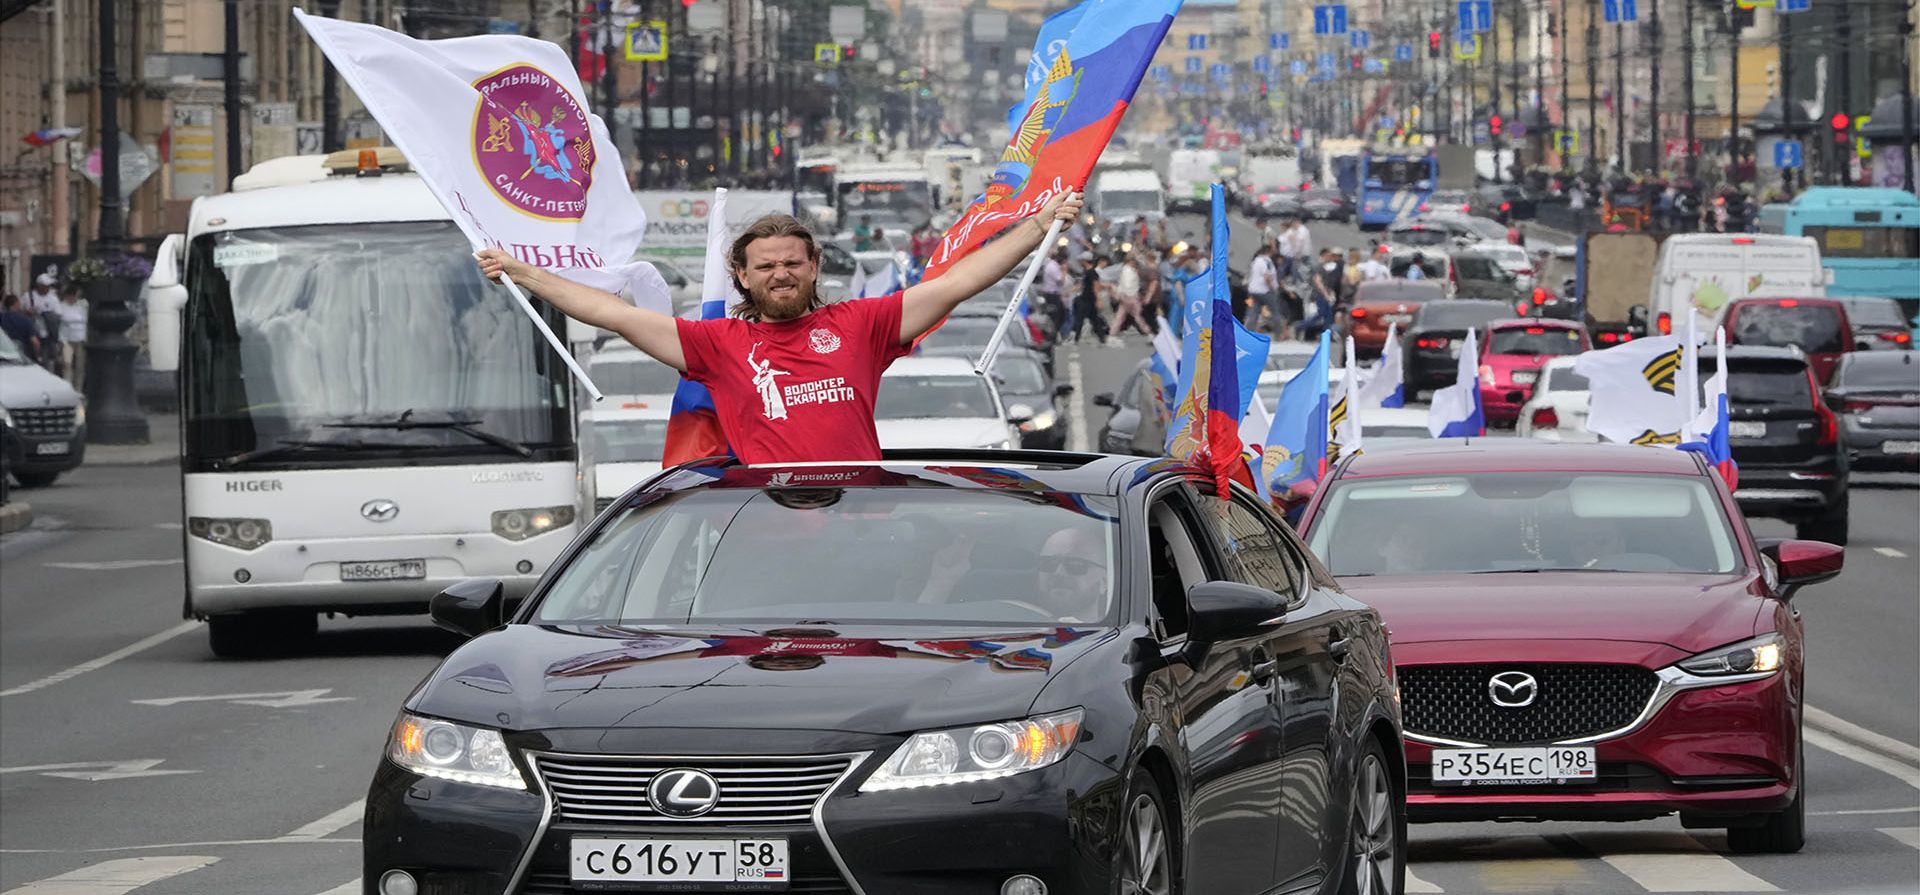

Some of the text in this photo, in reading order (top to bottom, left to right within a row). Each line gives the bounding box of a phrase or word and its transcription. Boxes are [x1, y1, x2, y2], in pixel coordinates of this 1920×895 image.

[481, 72, 550, 98] РАЛЬНЫЙ
[784, 377, 845, 396] ВОЛОНТЕР
[226, 479, 283, 492] HIGER
[1441, 750, 1587, 776] Р354ЕС 198
[586, 843, 774, 875] С616УТ 58
[737, 868, 763, 877] RUS
